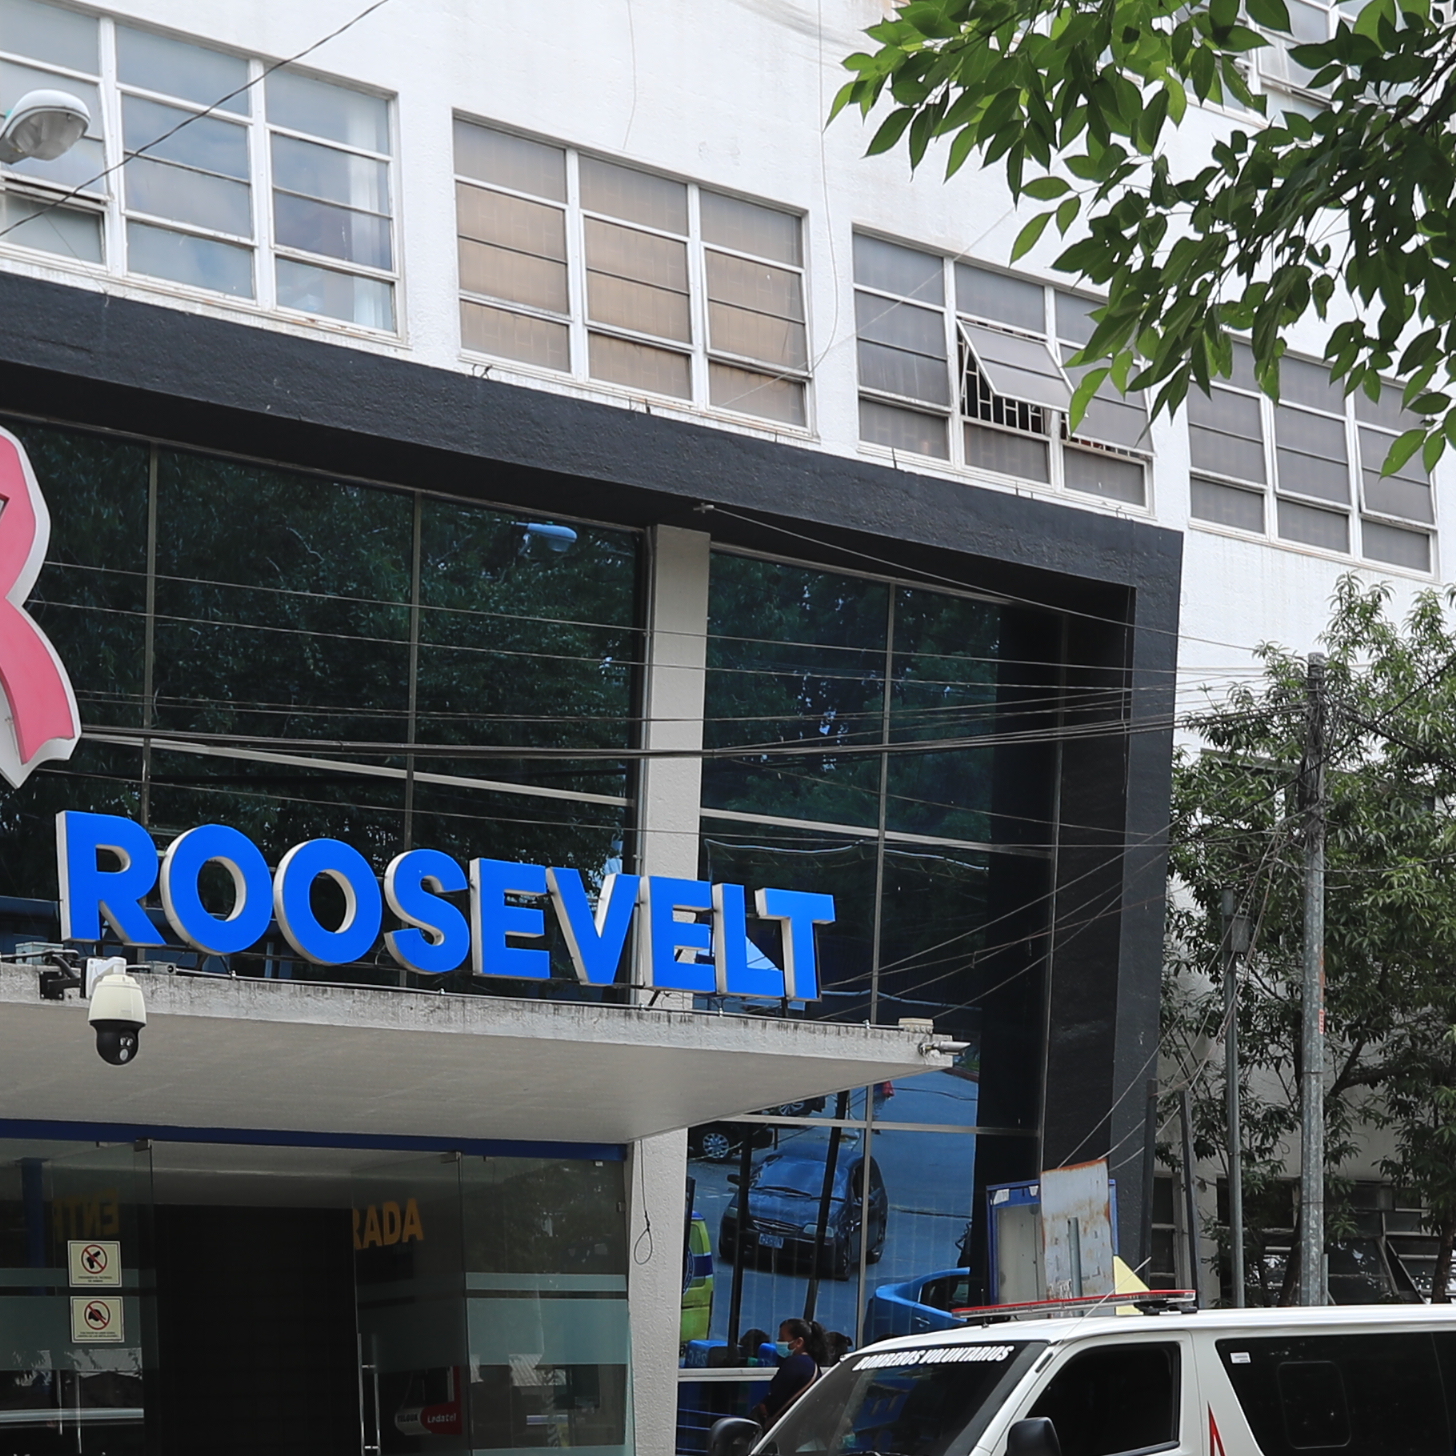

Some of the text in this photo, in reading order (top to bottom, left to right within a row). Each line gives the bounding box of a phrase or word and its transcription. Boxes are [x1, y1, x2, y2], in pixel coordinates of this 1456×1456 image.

[56, 811, 835, 1002] ROOSEVELT
[852, 1345, 1015, 1371] BOMBEROS VOLUNTARIOS
